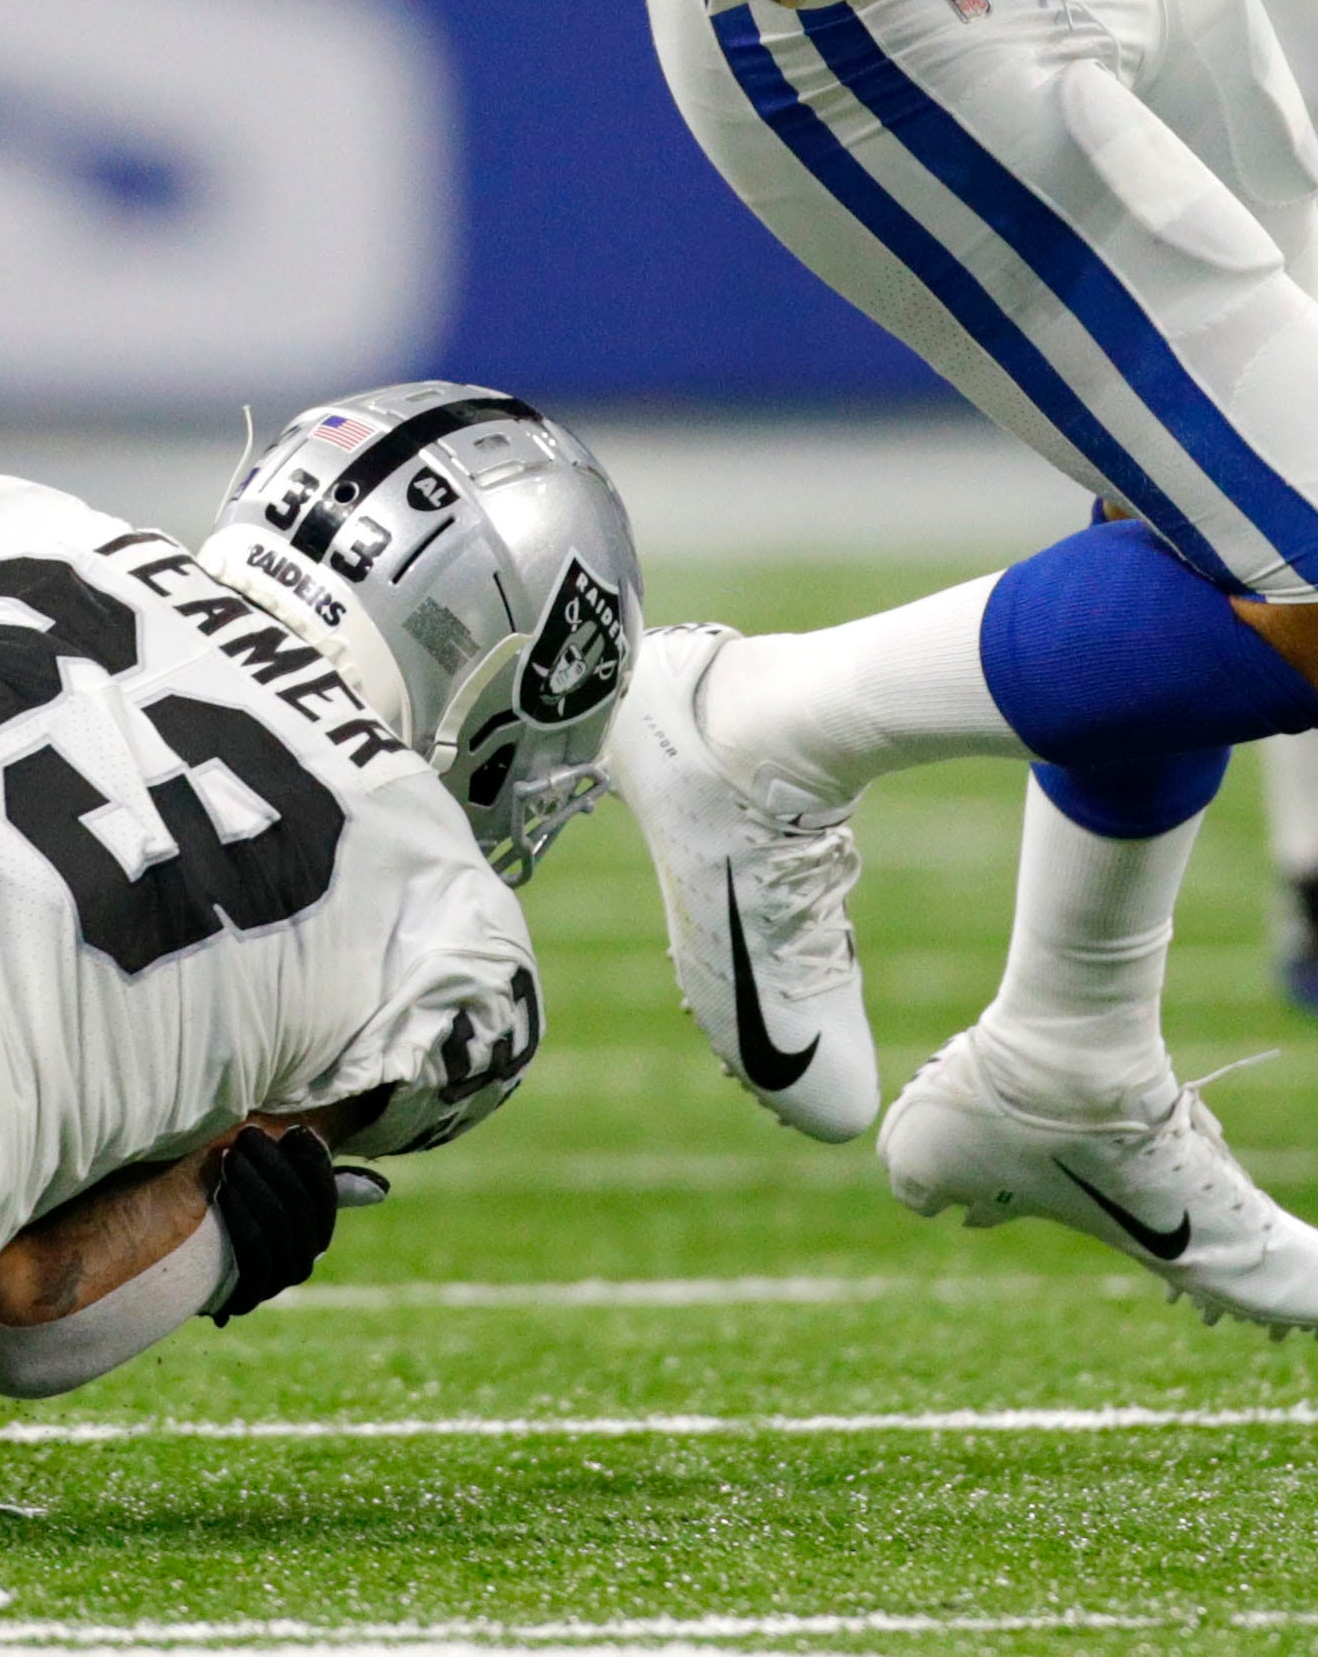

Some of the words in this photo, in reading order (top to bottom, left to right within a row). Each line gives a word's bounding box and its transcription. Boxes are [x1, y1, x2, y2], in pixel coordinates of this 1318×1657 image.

[412, 476, 450, 508] AL
[245, 543, 348, 628] RAIDERS
[574, 572, 623, 642] RAIDE
[642, 713, 679, 759] VAPOR
